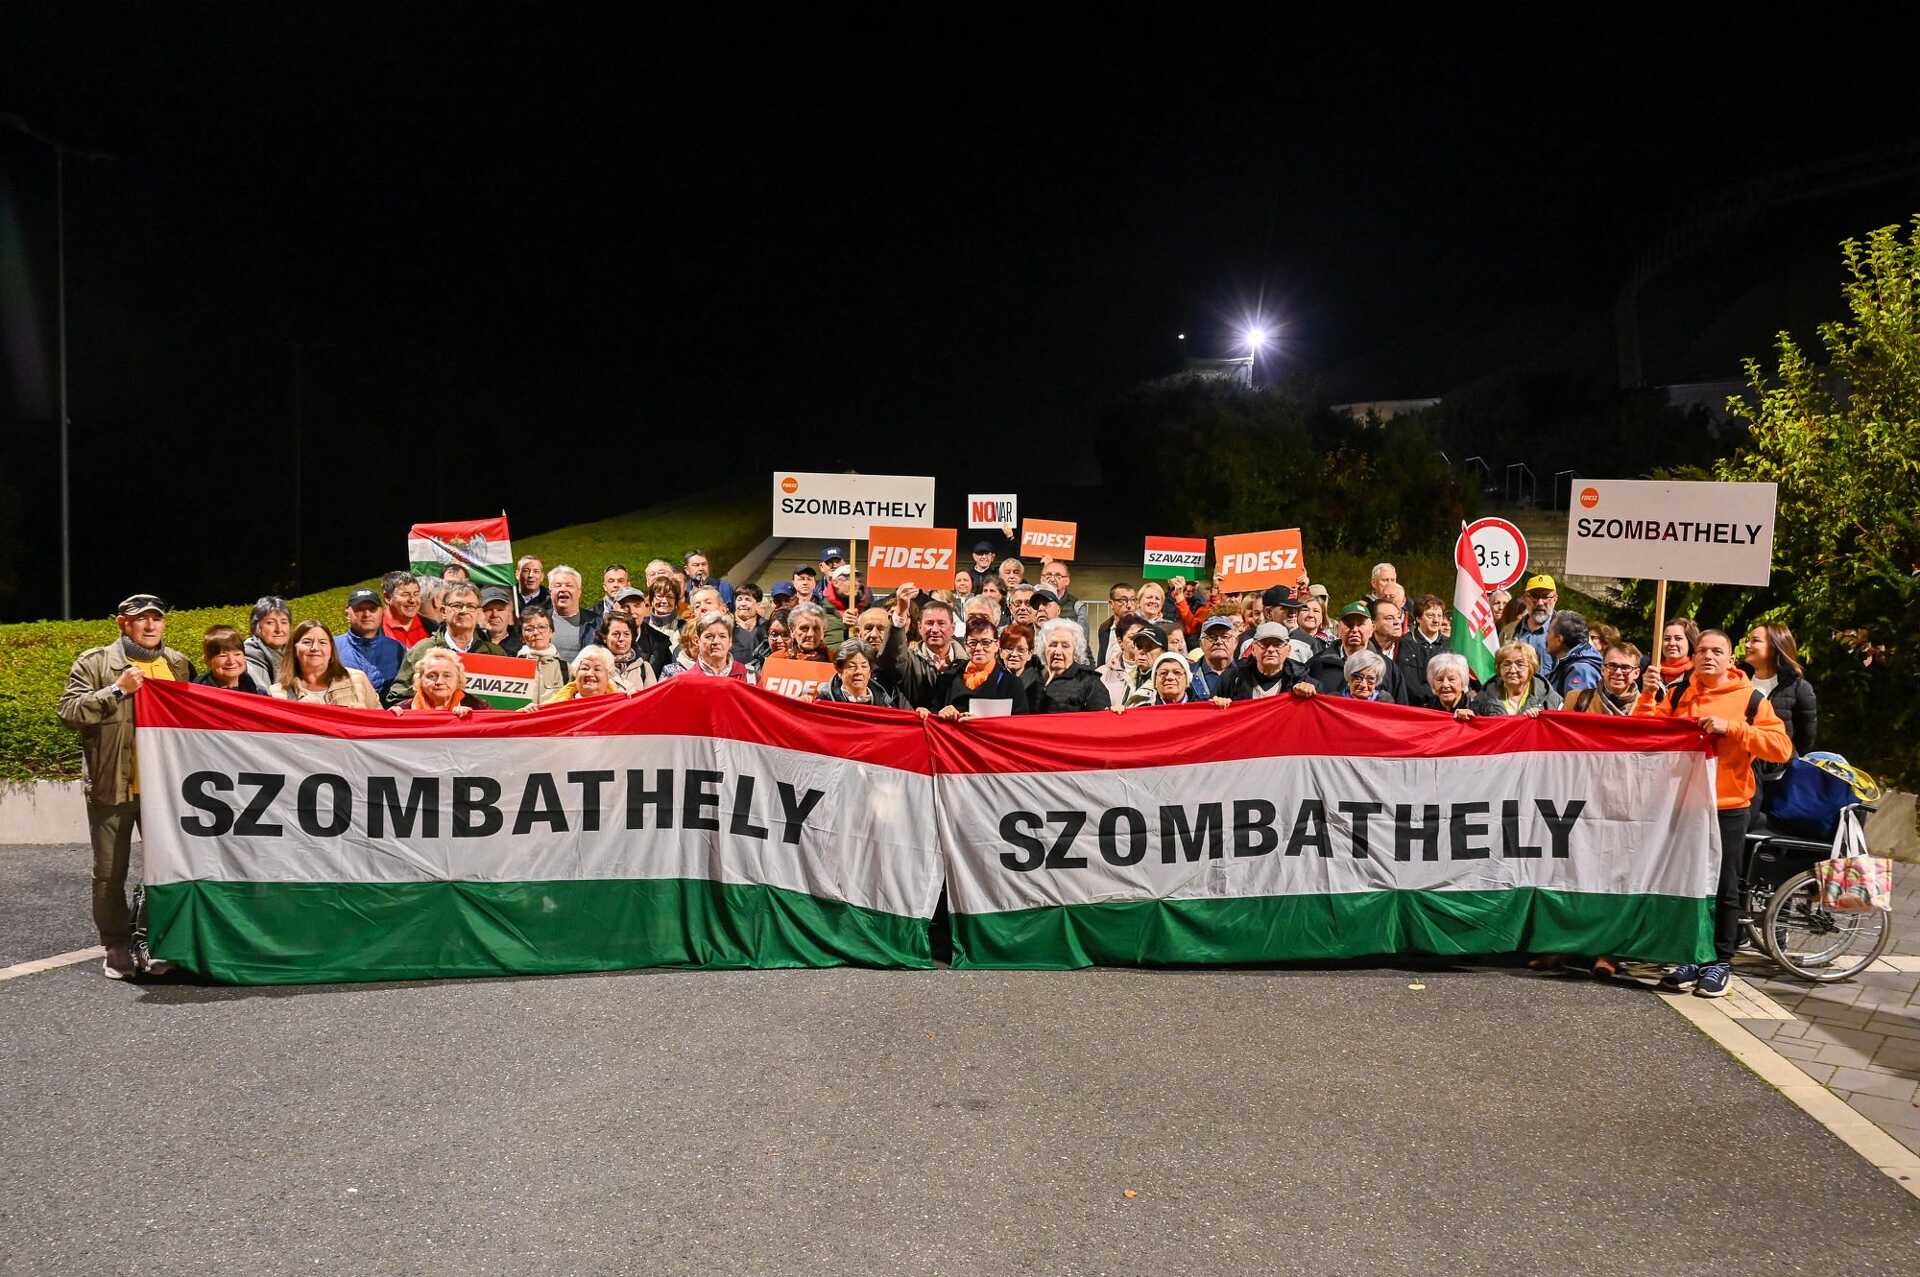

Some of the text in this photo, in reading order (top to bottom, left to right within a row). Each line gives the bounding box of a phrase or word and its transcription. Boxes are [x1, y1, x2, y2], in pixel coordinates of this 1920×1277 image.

[781, 498, 927, 518] SZOMBATHELY
[972, 501, 996, 523] NO
[1023, 532, 1073, 549] FIDESZ
[1577, 518, 1763, 545] SZOMBATHELY
[869, 546, 953, 570] FIDESZ
[1148, 552, 1202, 565] SZAVAZZ!
[1222, 549, 1298, 576] FIDESZ
[1504, 550, 1511, 567] t
[465, 677, 529, 695] ZAVAZZ!
[180, 768, 824, 844] SZOMBATHELY
[999, 798, 1587, 872] SZOMBATHELY
